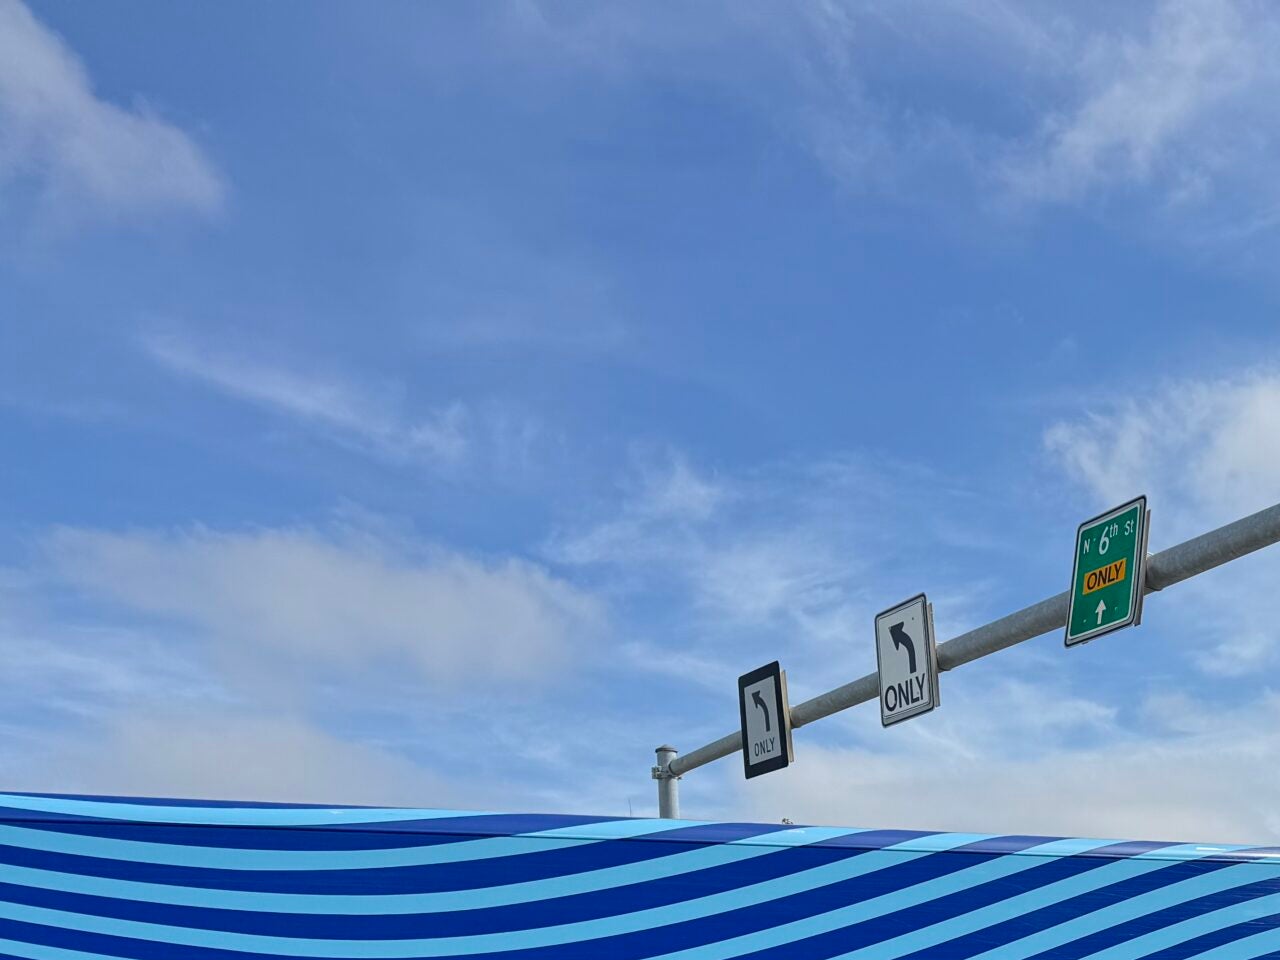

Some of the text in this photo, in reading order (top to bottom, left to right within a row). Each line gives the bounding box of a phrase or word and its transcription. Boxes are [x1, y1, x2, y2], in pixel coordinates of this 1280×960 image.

[1083, 519, 1134, 555] N 6th St
[1086, 561, 1123, 590] ONLY
[884, 673, 926, 712] ONLY
[754, 737, 775, 757] ONLY
